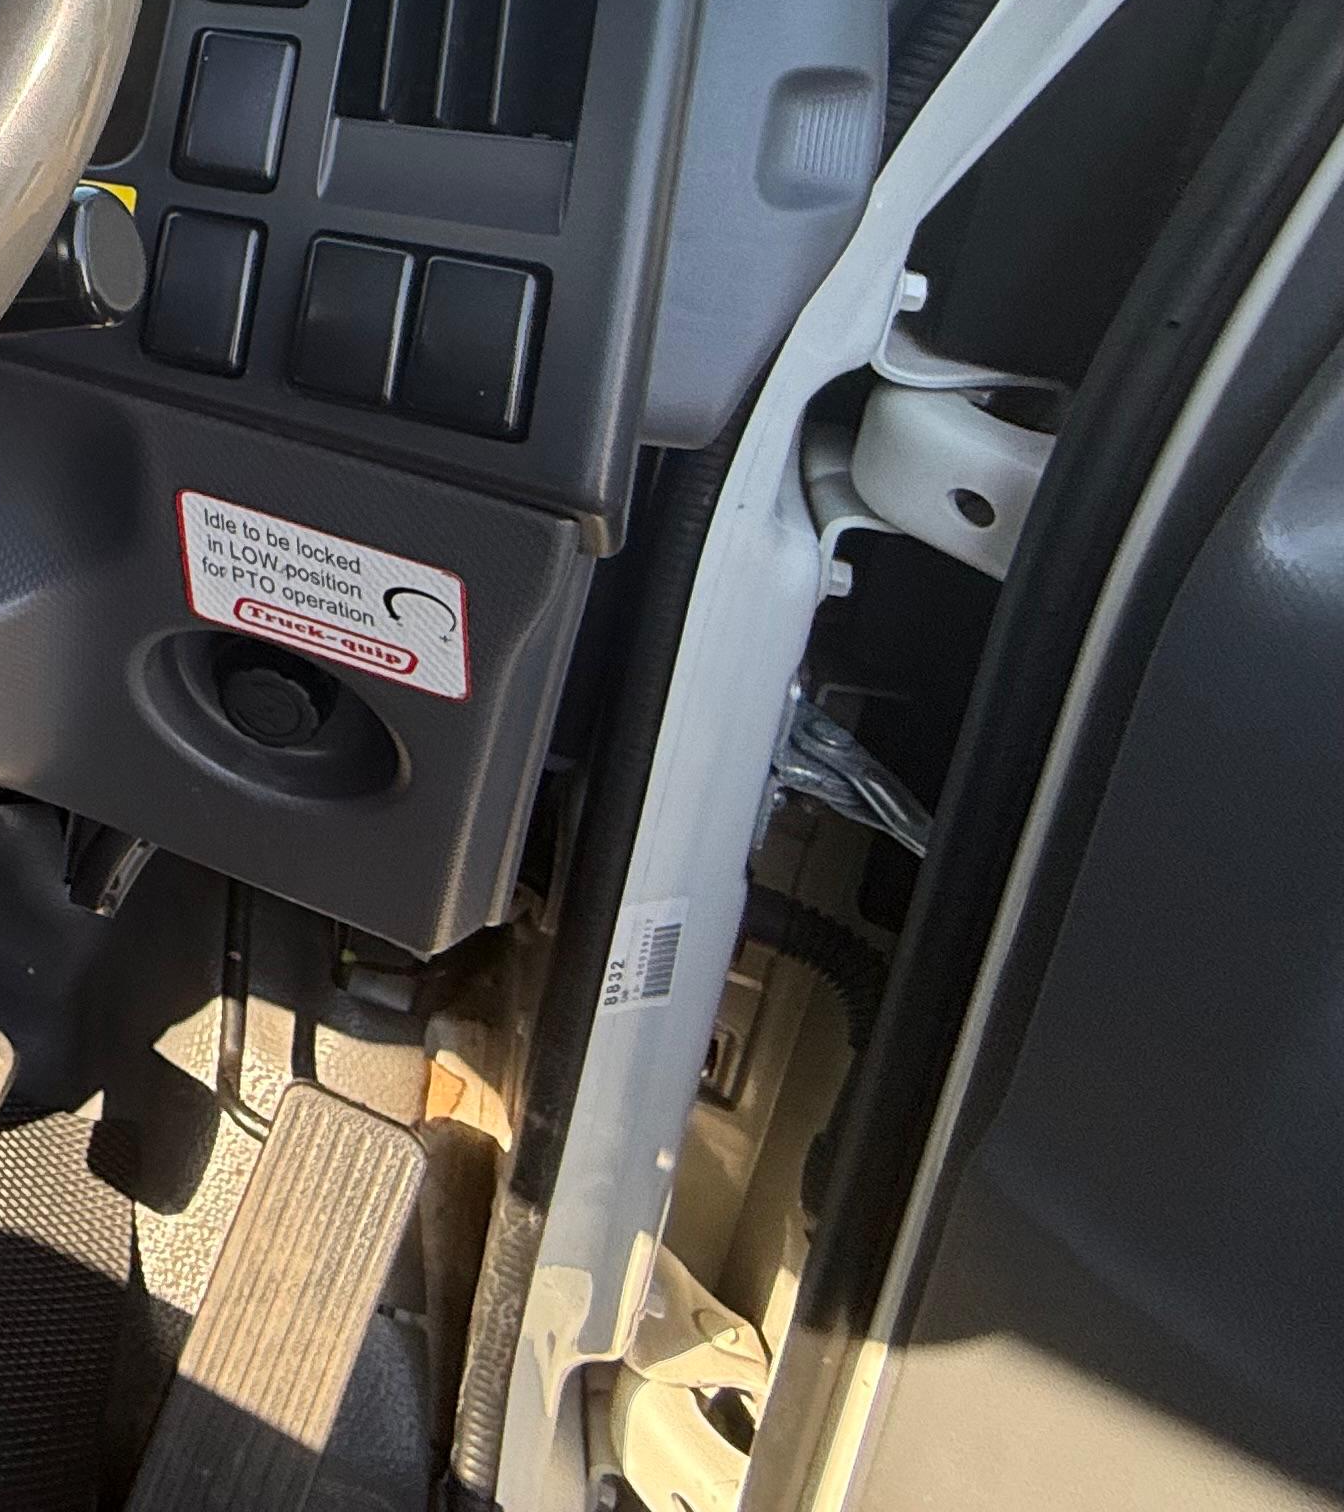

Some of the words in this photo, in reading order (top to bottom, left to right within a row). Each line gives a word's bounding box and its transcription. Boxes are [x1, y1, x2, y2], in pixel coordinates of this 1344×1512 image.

[204, 507, 237, 535] Idle
[243, 521, 261, 542] to
[266, 527, 290, 552] be
[296, 536, 361, 576] locked
[207, 534, 224, 555] in
[229, 540, 279, 572] LOW
[285, 563, 362, 600] position
[201, 555, 228, 578] for
[232, 565, 276, 594] PTO
[282, 587, 375, 627] operation
[247, 605, 403, 666] Truck-quip
